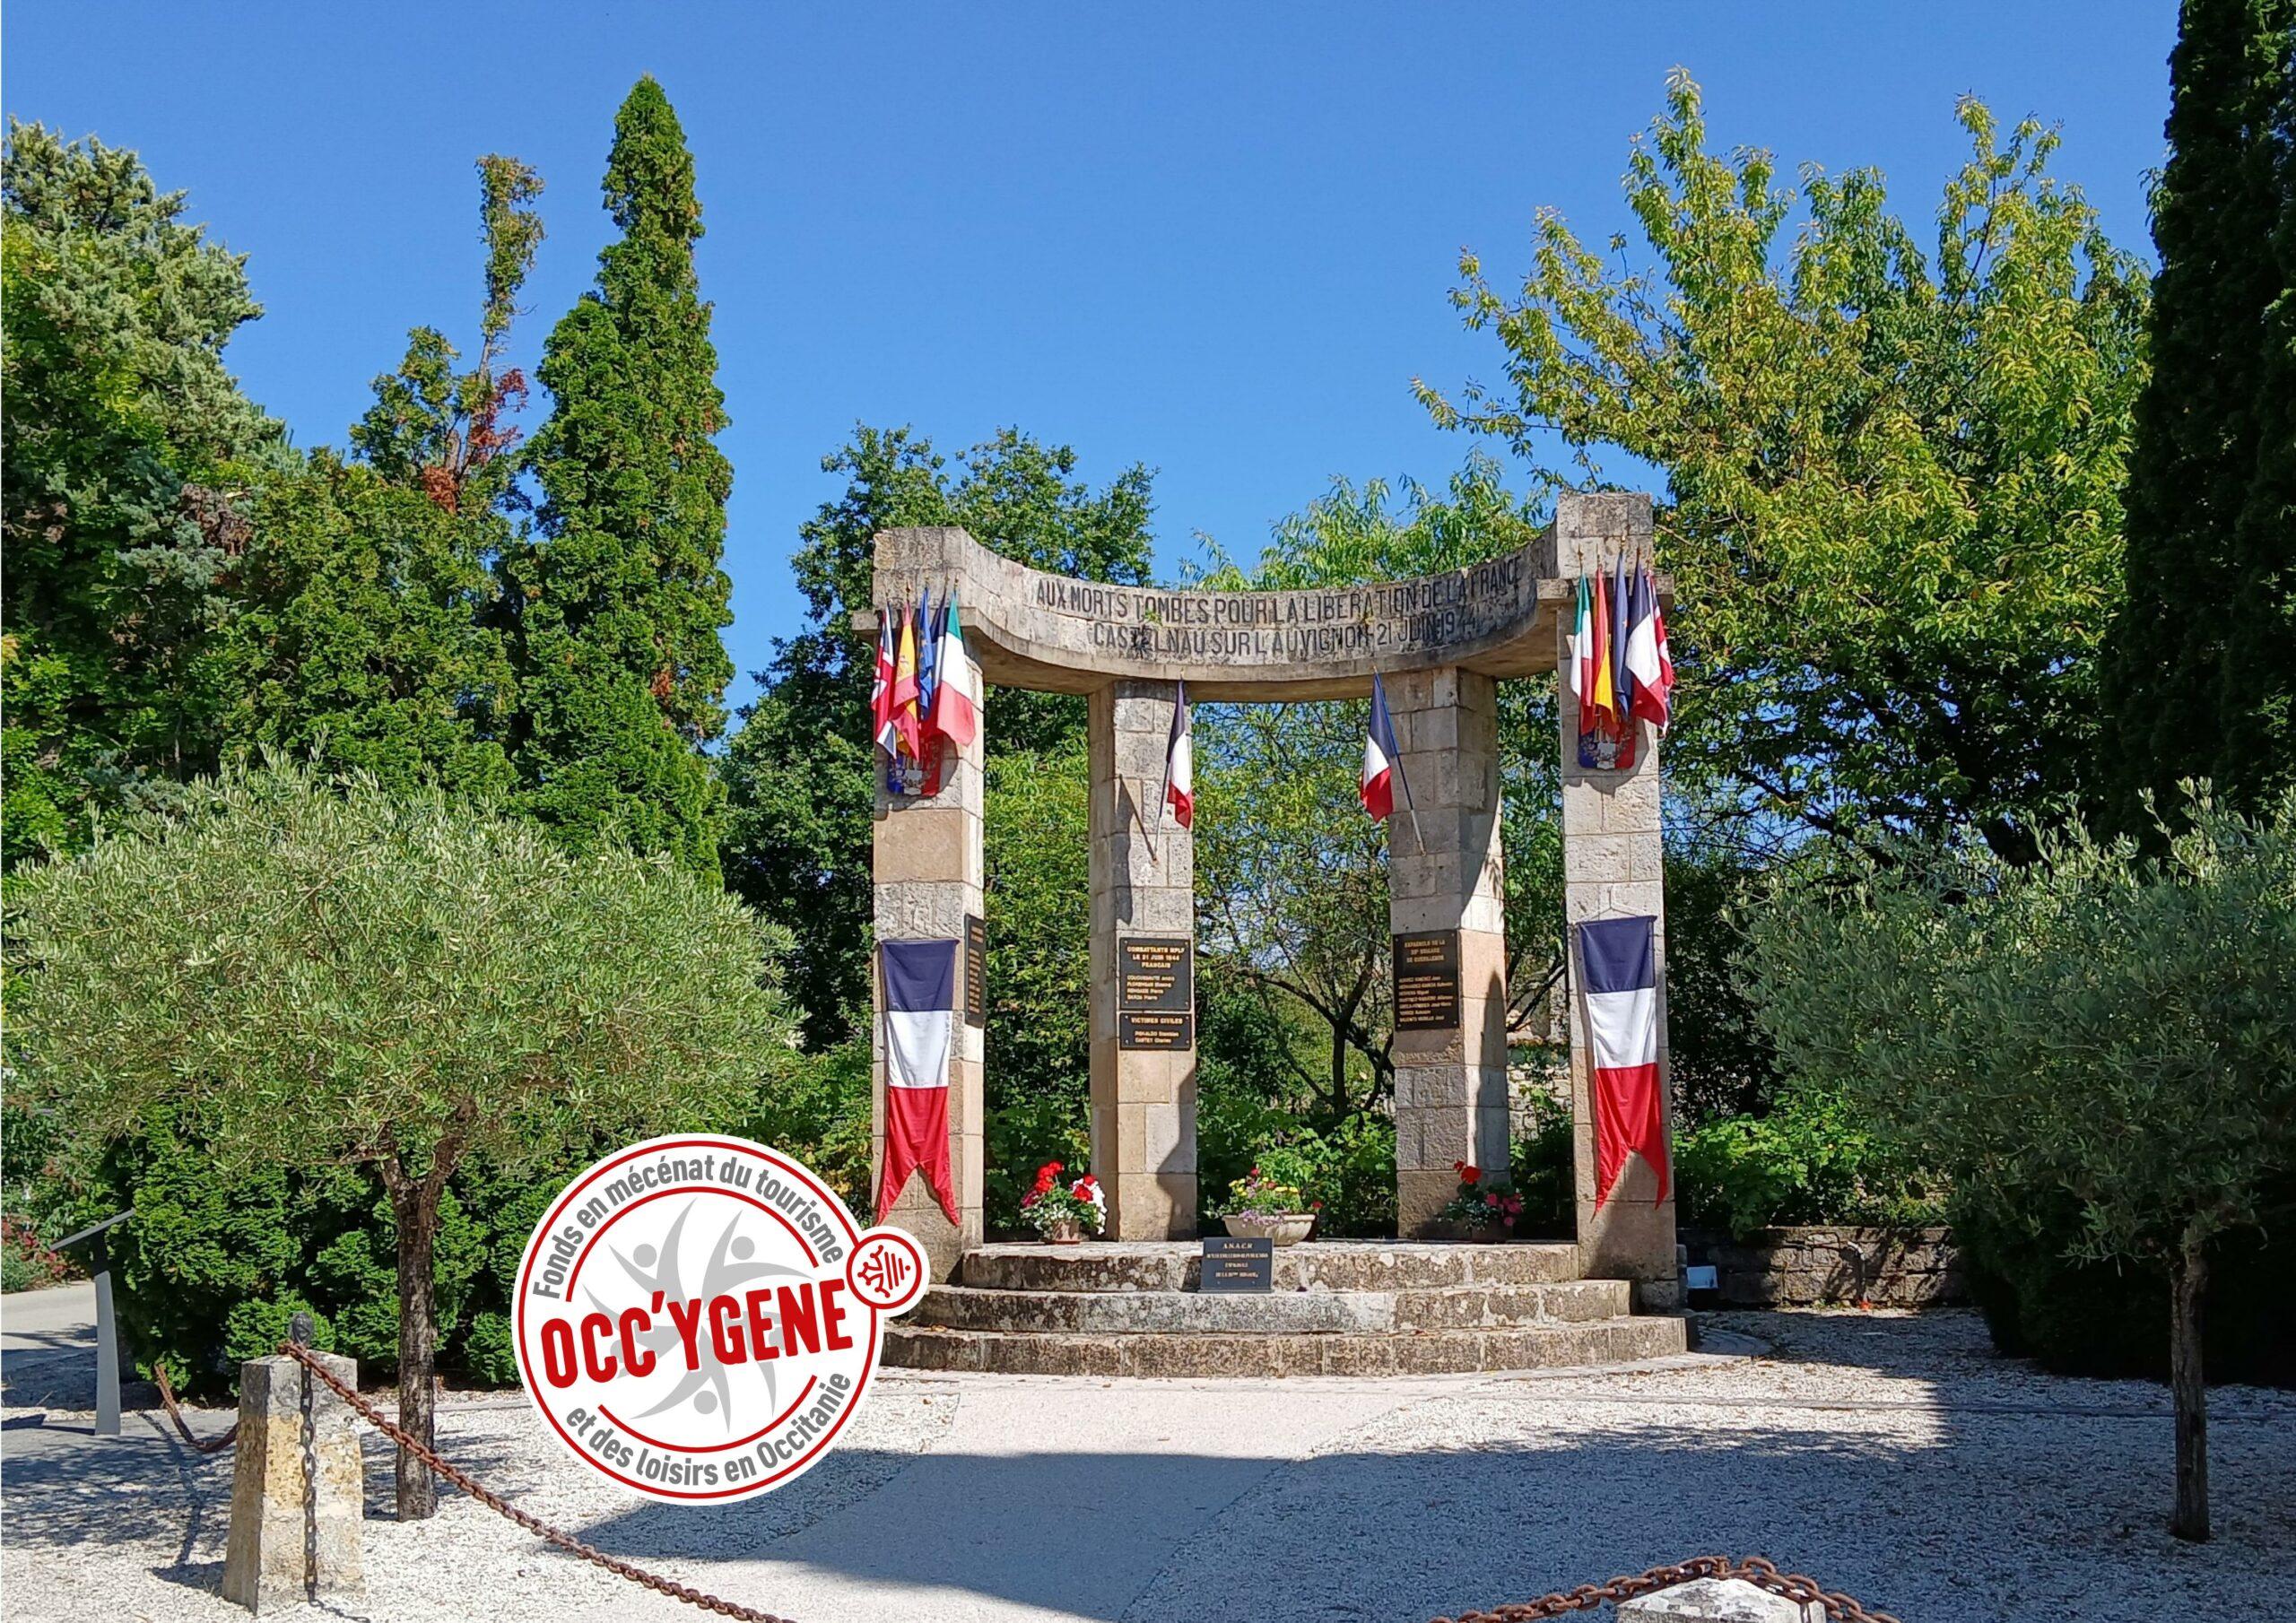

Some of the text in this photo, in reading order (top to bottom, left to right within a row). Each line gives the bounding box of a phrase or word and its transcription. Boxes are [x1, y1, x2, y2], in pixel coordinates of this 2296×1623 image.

[1037, 555, 1522, 624] AUX MORTS TOMBES POUR LA LIBERATION DE LA FRANCE
[1211, 632, 1250, 656] SUR
